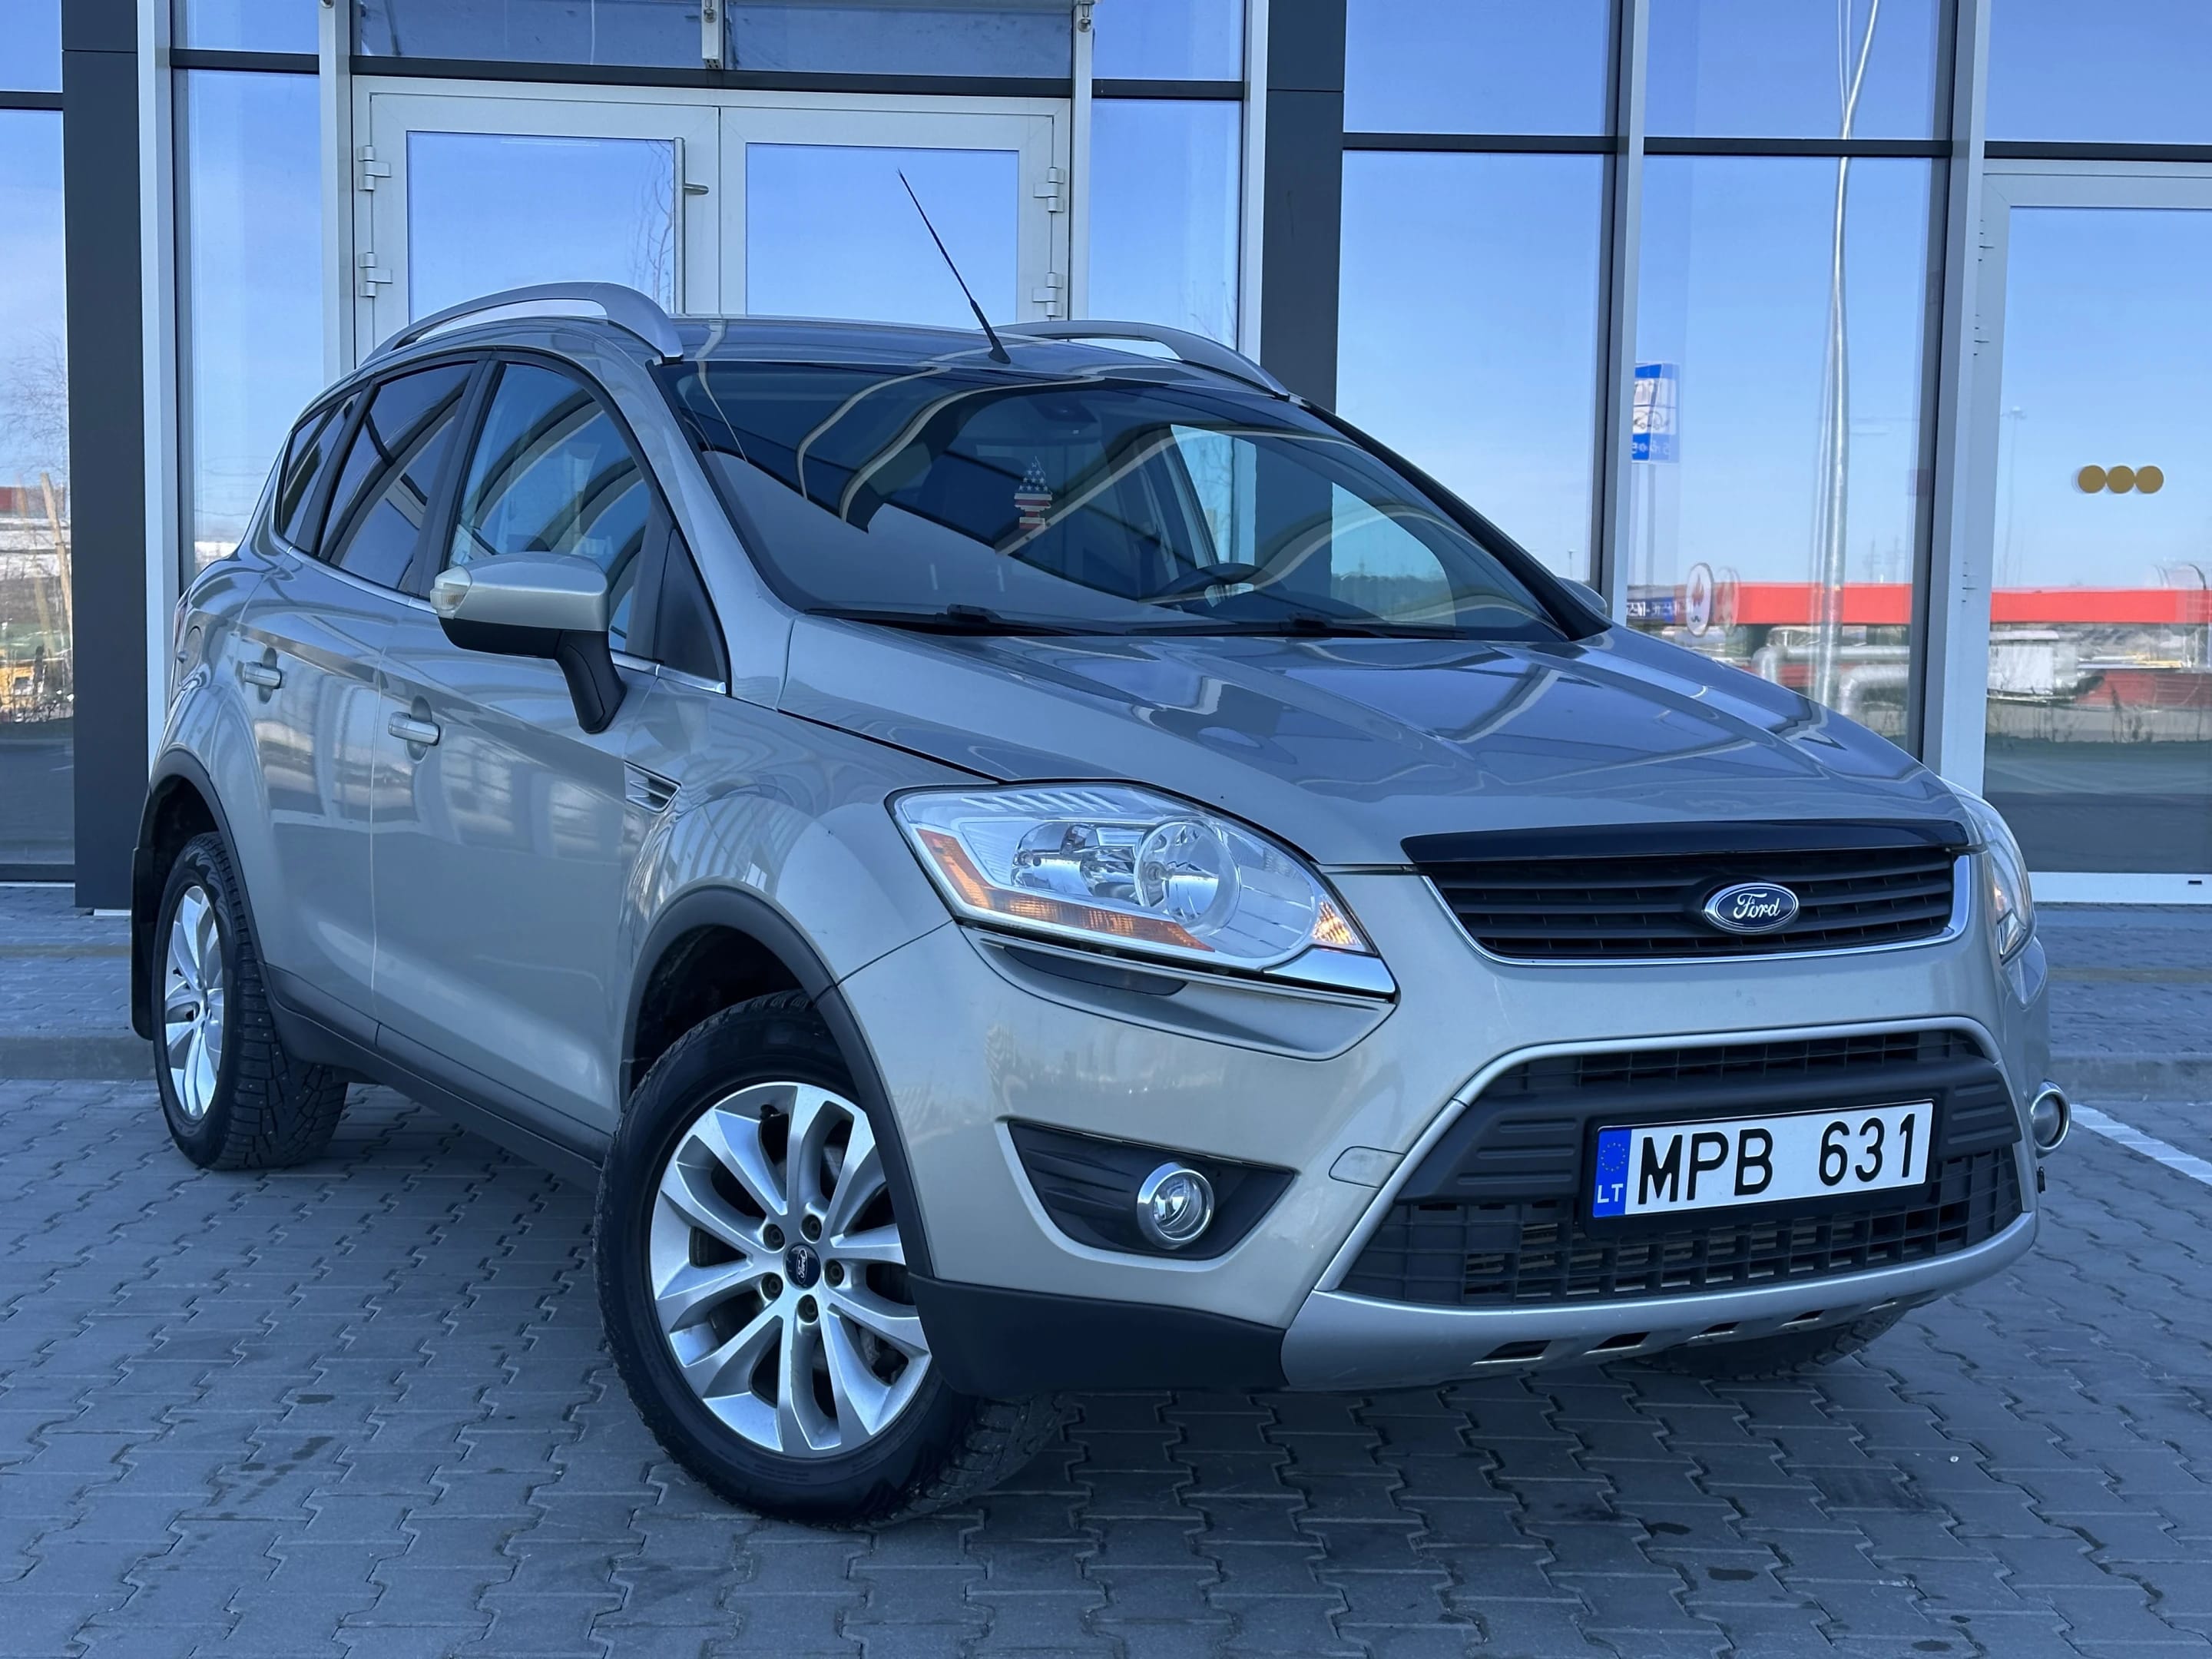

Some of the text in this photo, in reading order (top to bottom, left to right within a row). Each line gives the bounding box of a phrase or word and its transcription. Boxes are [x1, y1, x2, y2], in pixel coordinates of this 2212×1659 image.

[1733, 892, 1781, 919] Ford
[1637, 1113, 1916, 1205] MPB 631
[1597, 1184, 1624, 1204] LT
